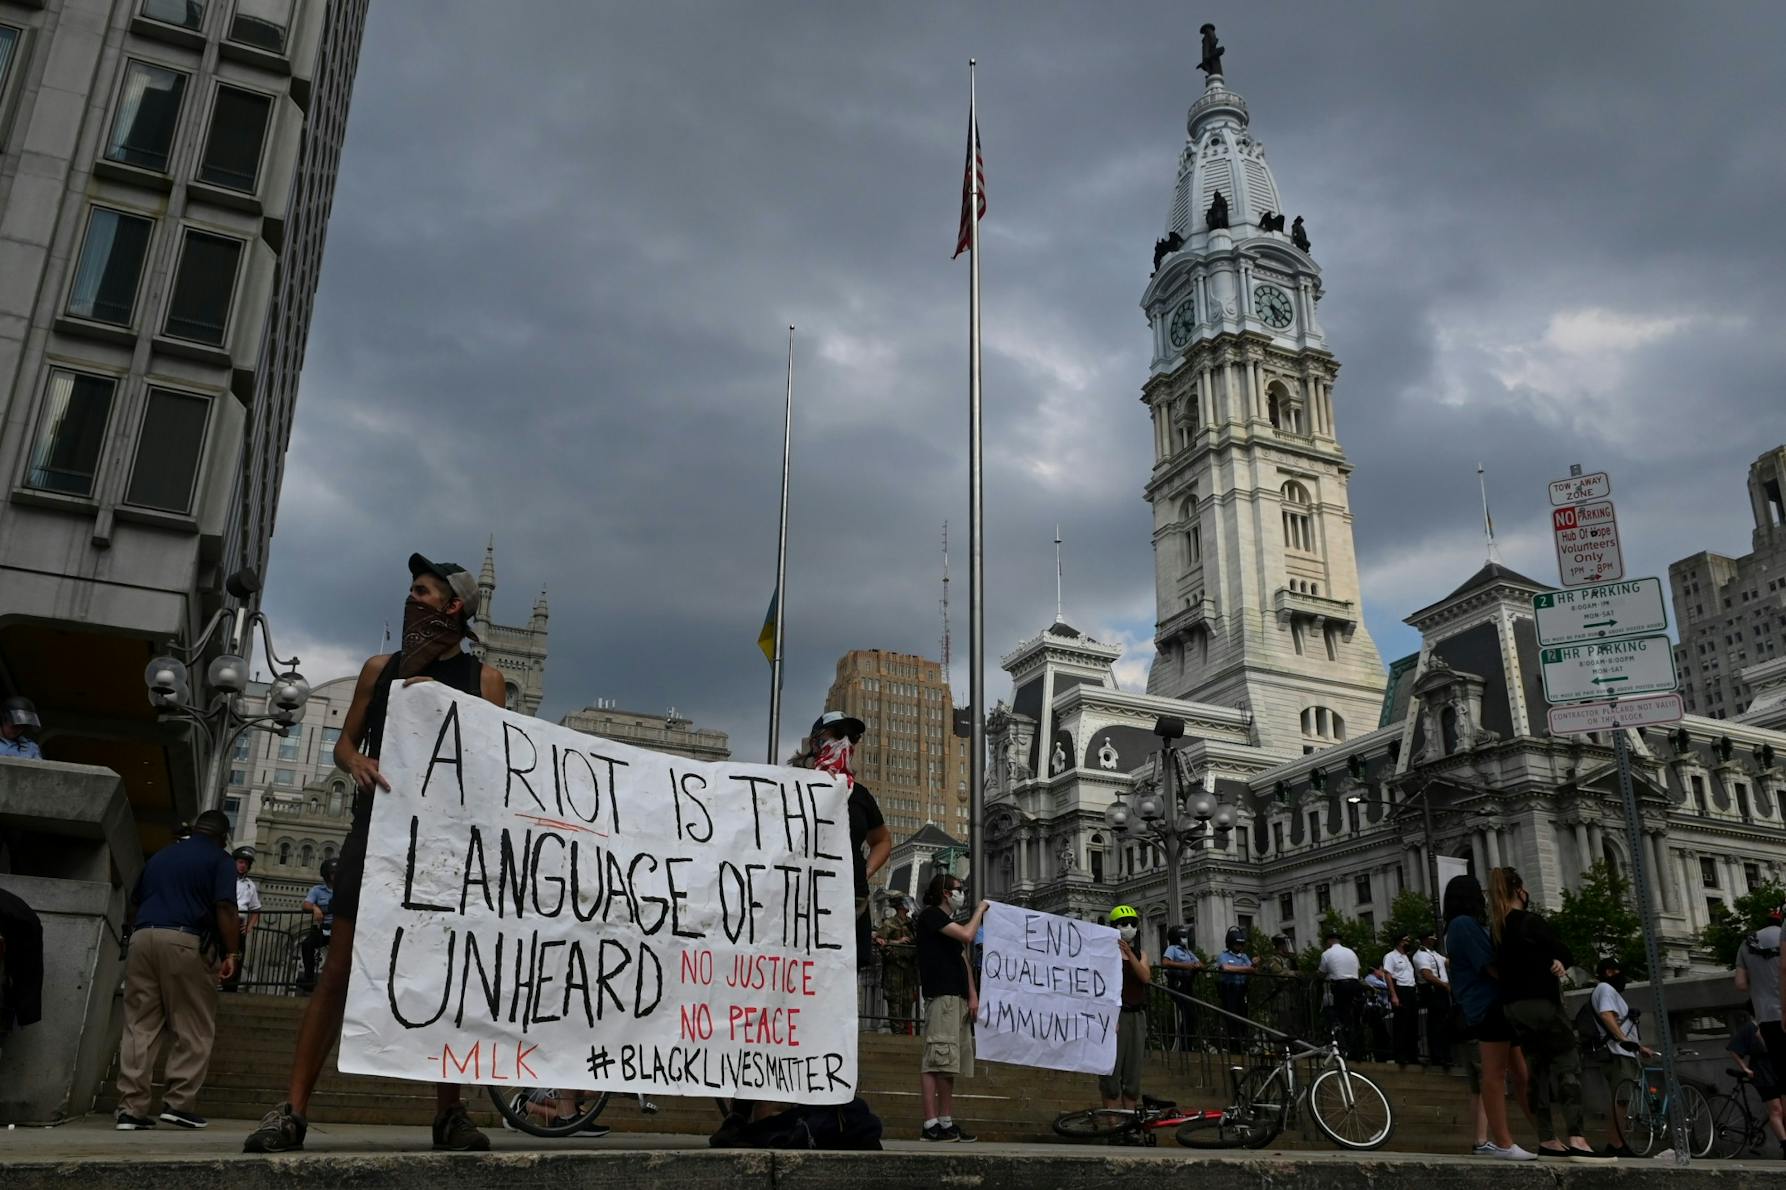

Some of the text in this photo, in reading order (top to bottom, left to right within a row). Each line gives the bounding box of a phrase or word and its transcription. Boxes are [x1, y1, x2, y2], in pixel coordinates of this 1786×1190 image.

[1553, 482, 1571, 492] TOW
[1580, 477, 1602, 488] AWAY
[1566, 489, 1594, 500] ZONE
[1555, 507, 1610, 527] NO PARKING
[1561, 540, 1616, 554] Volunteers
[1562, 528, 1610, 542] Hub Of ope
[1574, 553, 1604, 563] Only
[1540, 582, 1640, 607] 2 HR PARKING
[1563, 649, 1580, 659] HR
[1588, 640, 1646, 656] PARKING
[1554, 710, 1598, 720] CONTRACTOR
[1638, 702, 1652, 711] NOT
[421, 700, 844, 860] A RIOT IS THE
[400, 815, 842, 956] LANGUAGE OF THE
[1024, 914, 1082, 958] END
[387, 927, 663, 1033] UNHEARD
[680, 949, 816, 996] NO JUSTICE
[984, 950, 1106, 998] QUALIFIED
[680, 1004, 801, 1047] NO PEACE
[983, 1000, 1110, 1044] IMMUNITY
[586, 1043, 852, 1094] #BLACKLIVESMATTER
